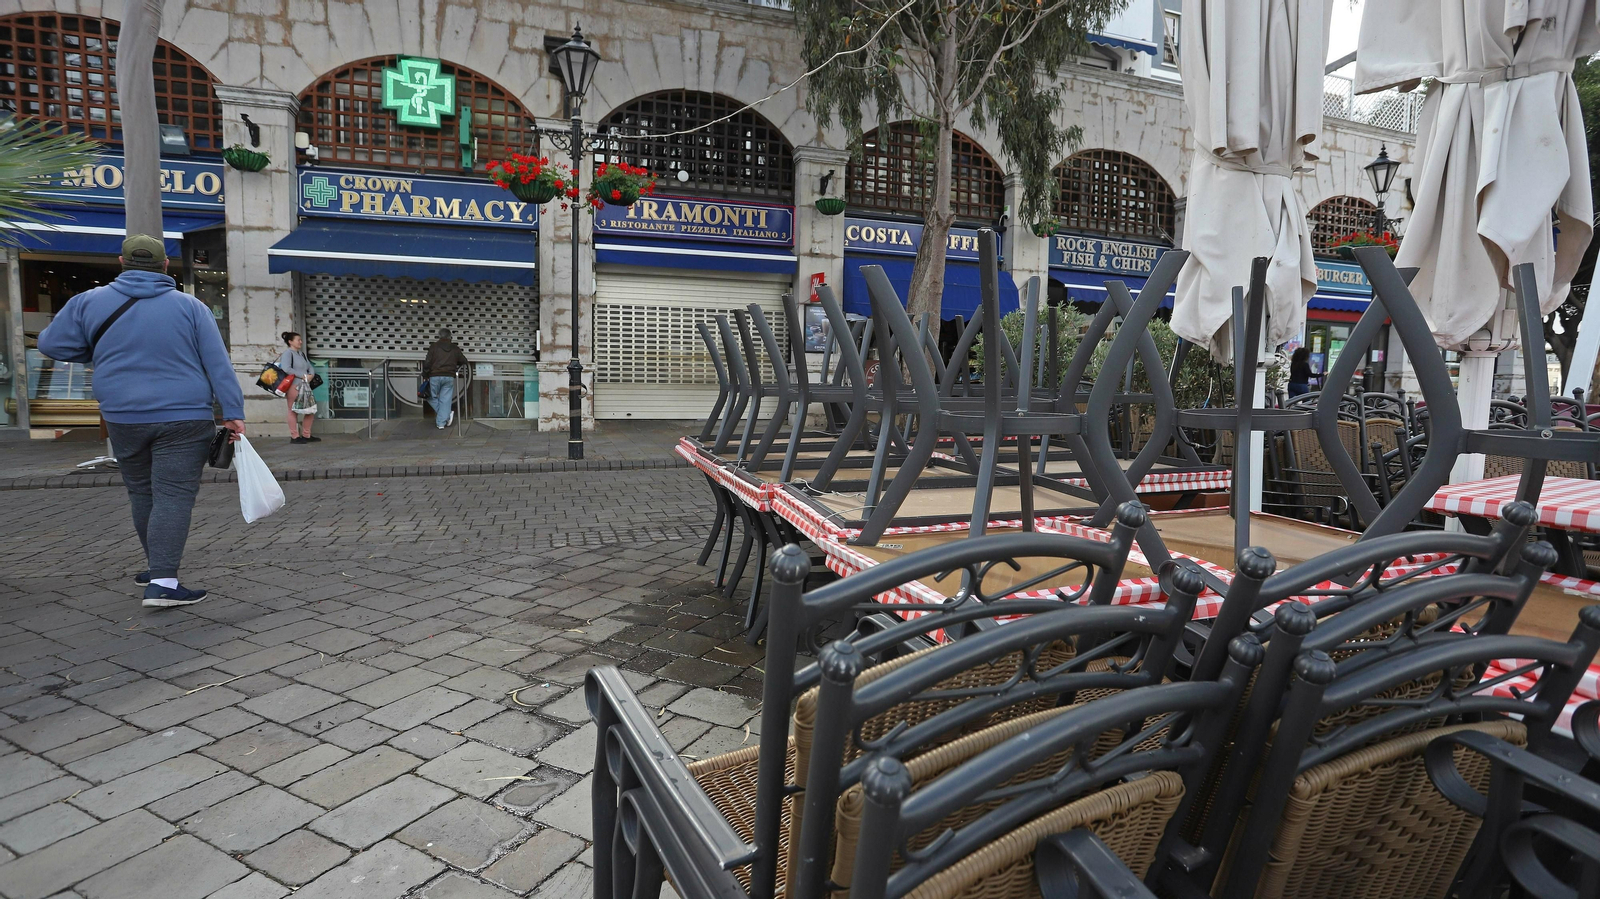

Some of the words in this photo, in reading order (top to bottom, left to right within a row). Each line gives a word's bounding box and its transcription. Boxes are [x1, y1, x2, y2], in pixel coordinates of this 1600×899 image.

[60, 163, 222, 196] MOELO
[339, 174, 413, 194] CROWN
[303, 199, 311, 209] 4
[339, 190, 528, 223] PHARMACY
[625, 199, 768, 229] TRAMONTI
[526, 213, 533, 222] 4
[600, 219, 607, 227] 3
[610, 219, 675, 232] RISTORANTE
[680, 225, 727, 236] PIZZERIA
[732, 228, 779, 239] ITALIANO
[845, 224, 914, 246] COSTA
[1056, 236, 1097, 254] ROCK
[1101, 241, 1158, 260] ENGLISH
[1062, 251, 1095, 267] FISH
[1098, 256, 1108, 268] &
[1111, 257, 1152, 272] CHIPS
[1317, 268, 1363, 285] BURGER
[328, 379, 361, 388] ROWN
